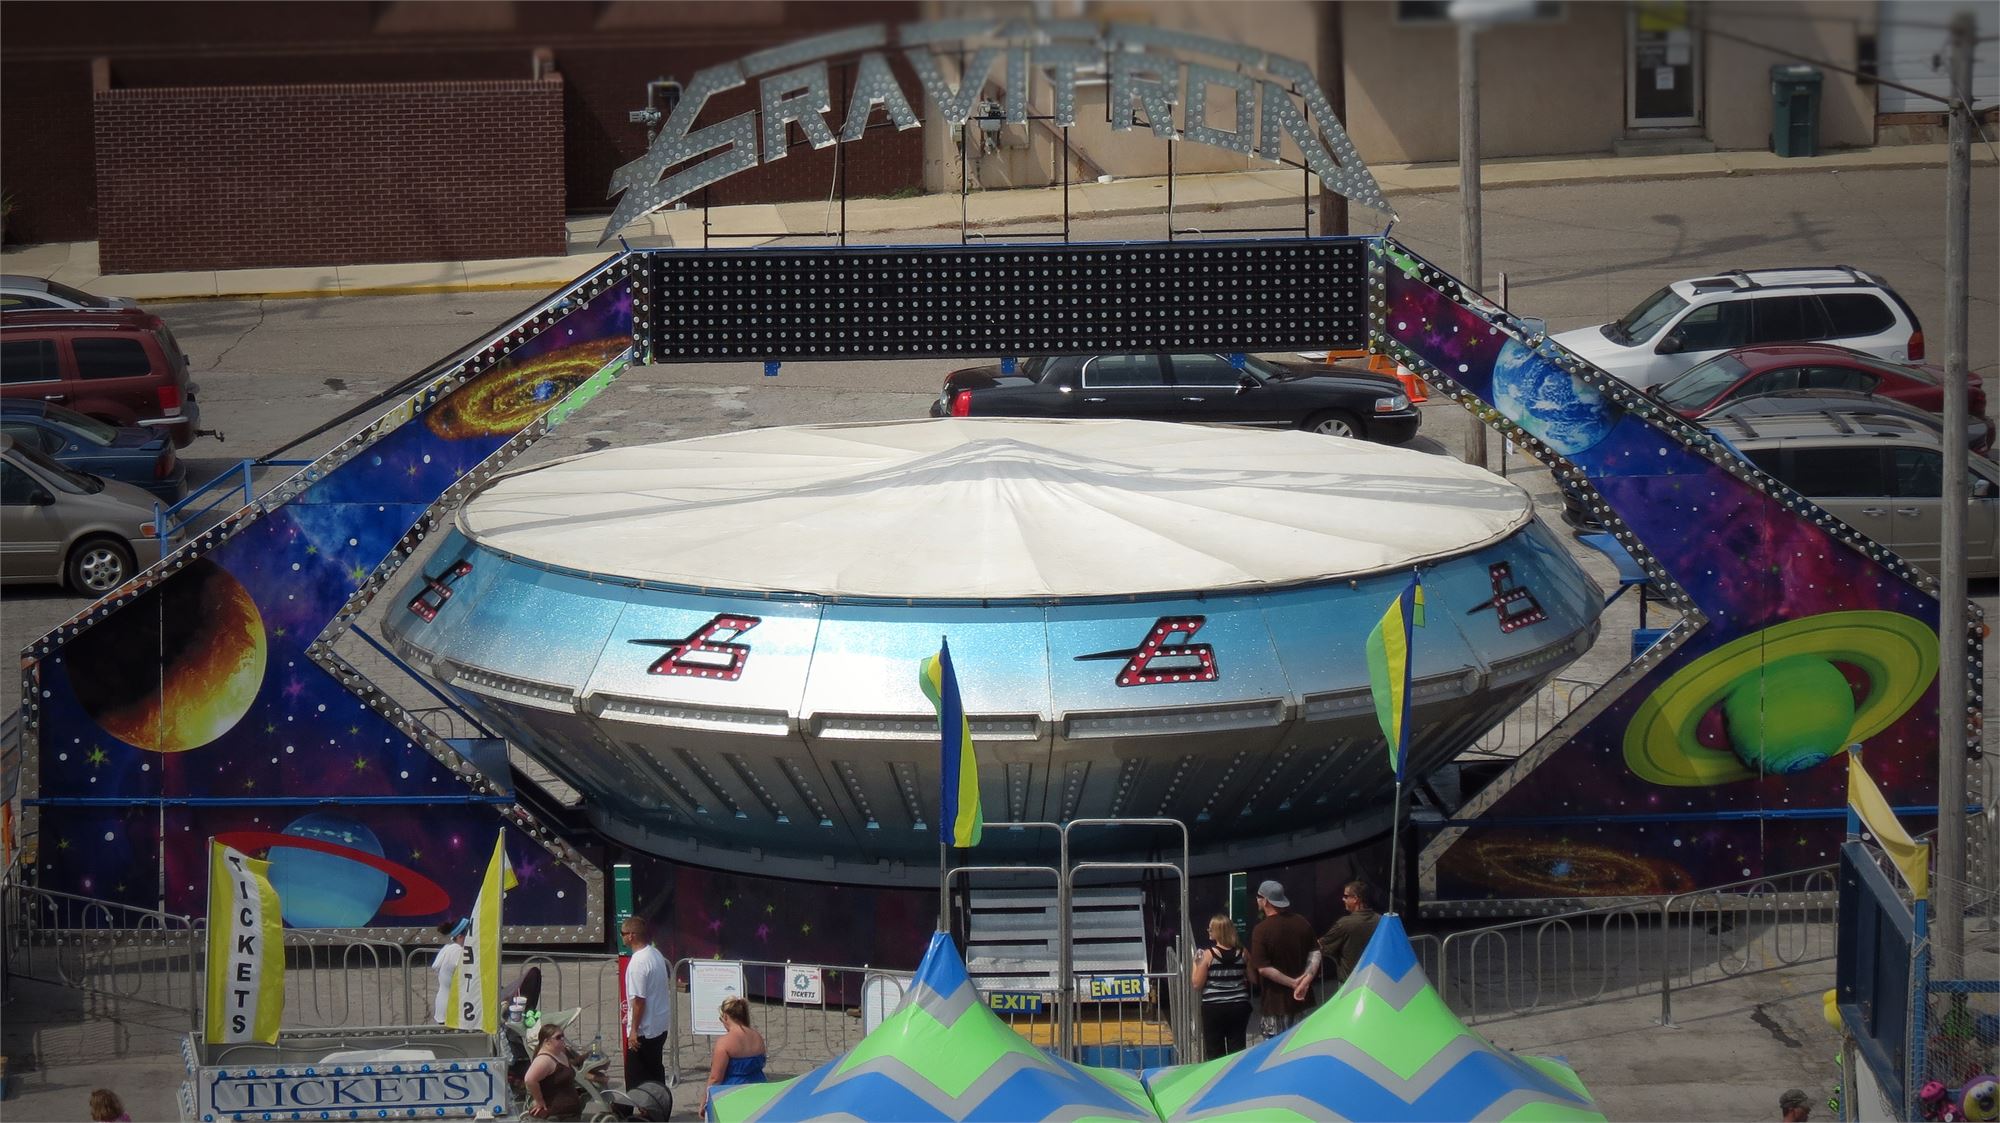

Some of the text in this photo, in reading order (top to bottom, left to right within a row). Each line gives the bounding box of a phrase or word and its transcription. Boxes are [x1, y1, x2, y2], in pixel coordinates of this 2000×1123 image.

[598, 20, 1401, 247] GRAVITRON
[228, 855, 256, 1034] TICKETS
[796, 975, 806, 988] 4
[1091, 978, 1141, 997] ENTER
[790, 990, 816, 999] TICKETS
[990, 994, 1041, 1010] EXIT
[234, 1074, 471, 1109] TICKETS
